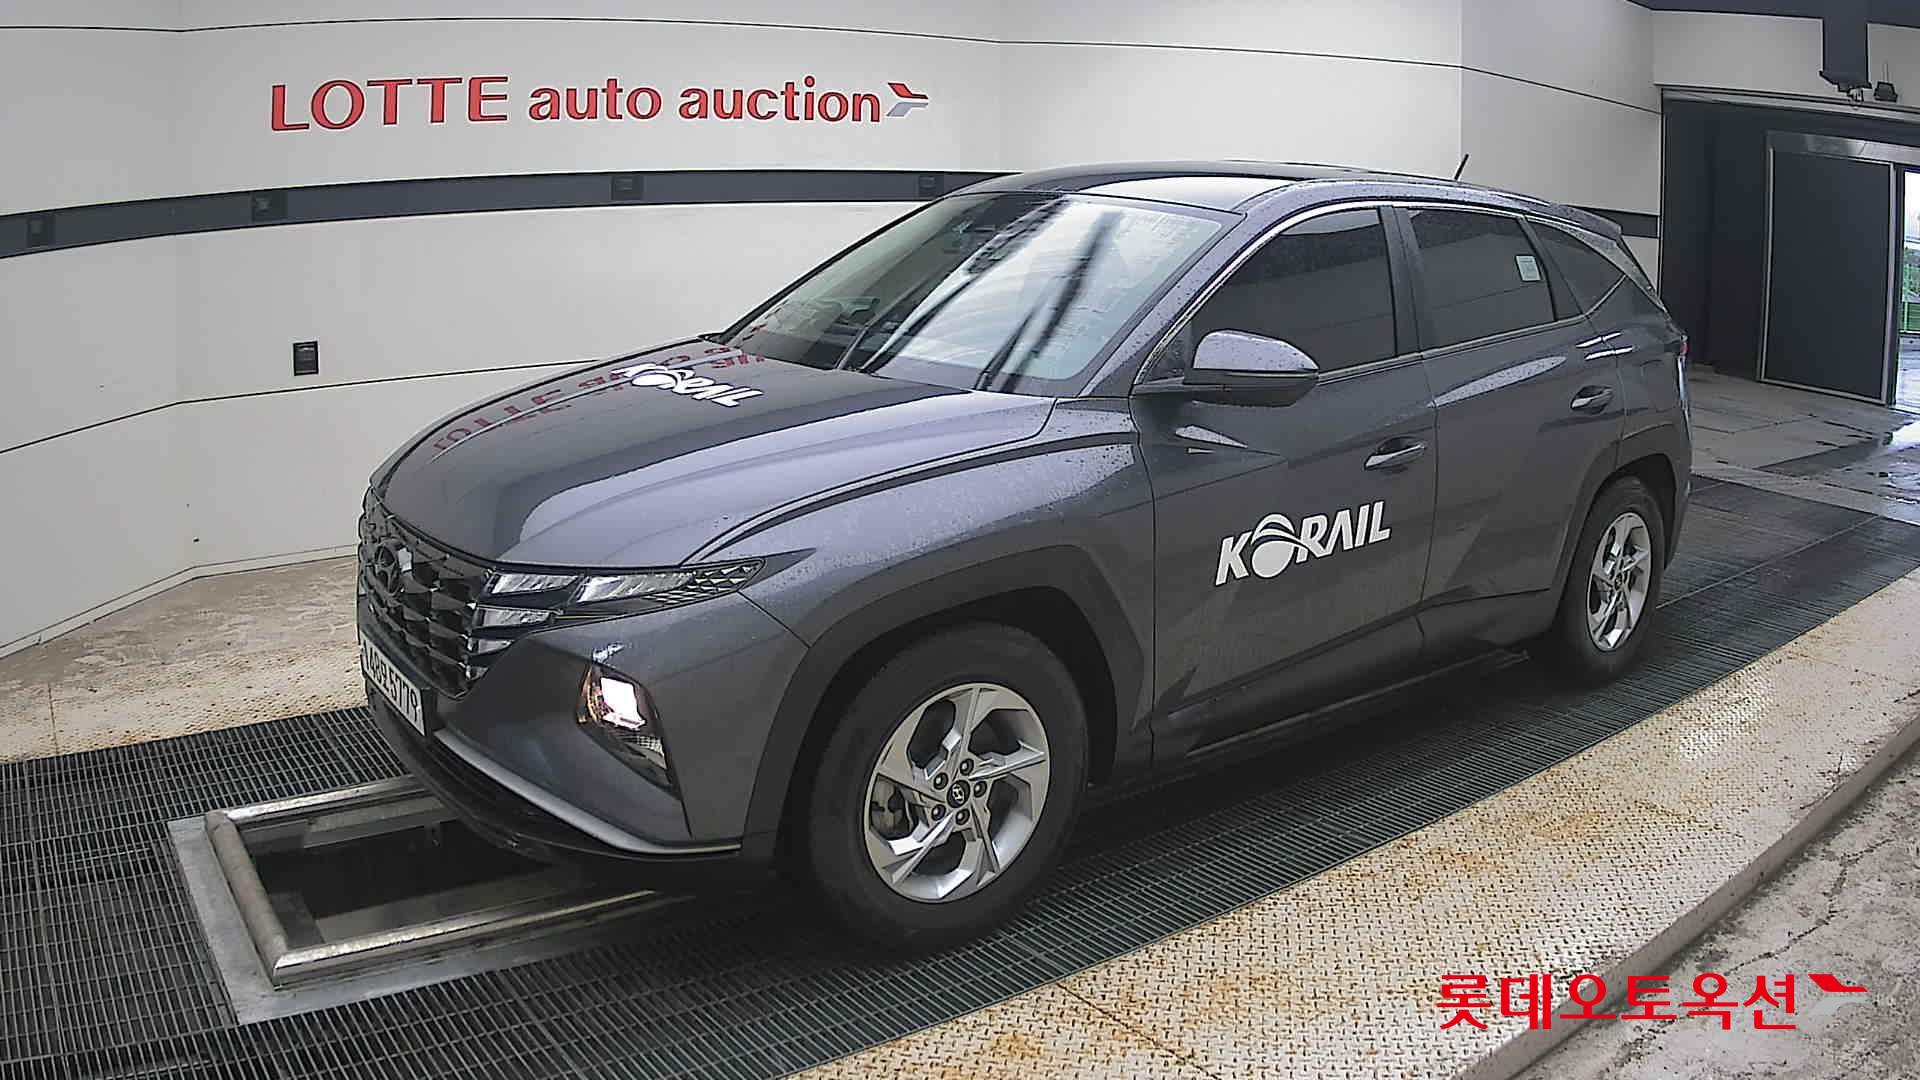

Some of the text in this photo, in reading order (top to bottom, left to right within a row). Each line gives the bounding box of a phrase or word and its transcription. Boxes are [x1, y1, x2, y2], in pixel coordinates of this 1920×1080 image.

[270, 76, 882, 132] LOTTE auto auction
[1215, 500, 1392, 586] KORAIL
